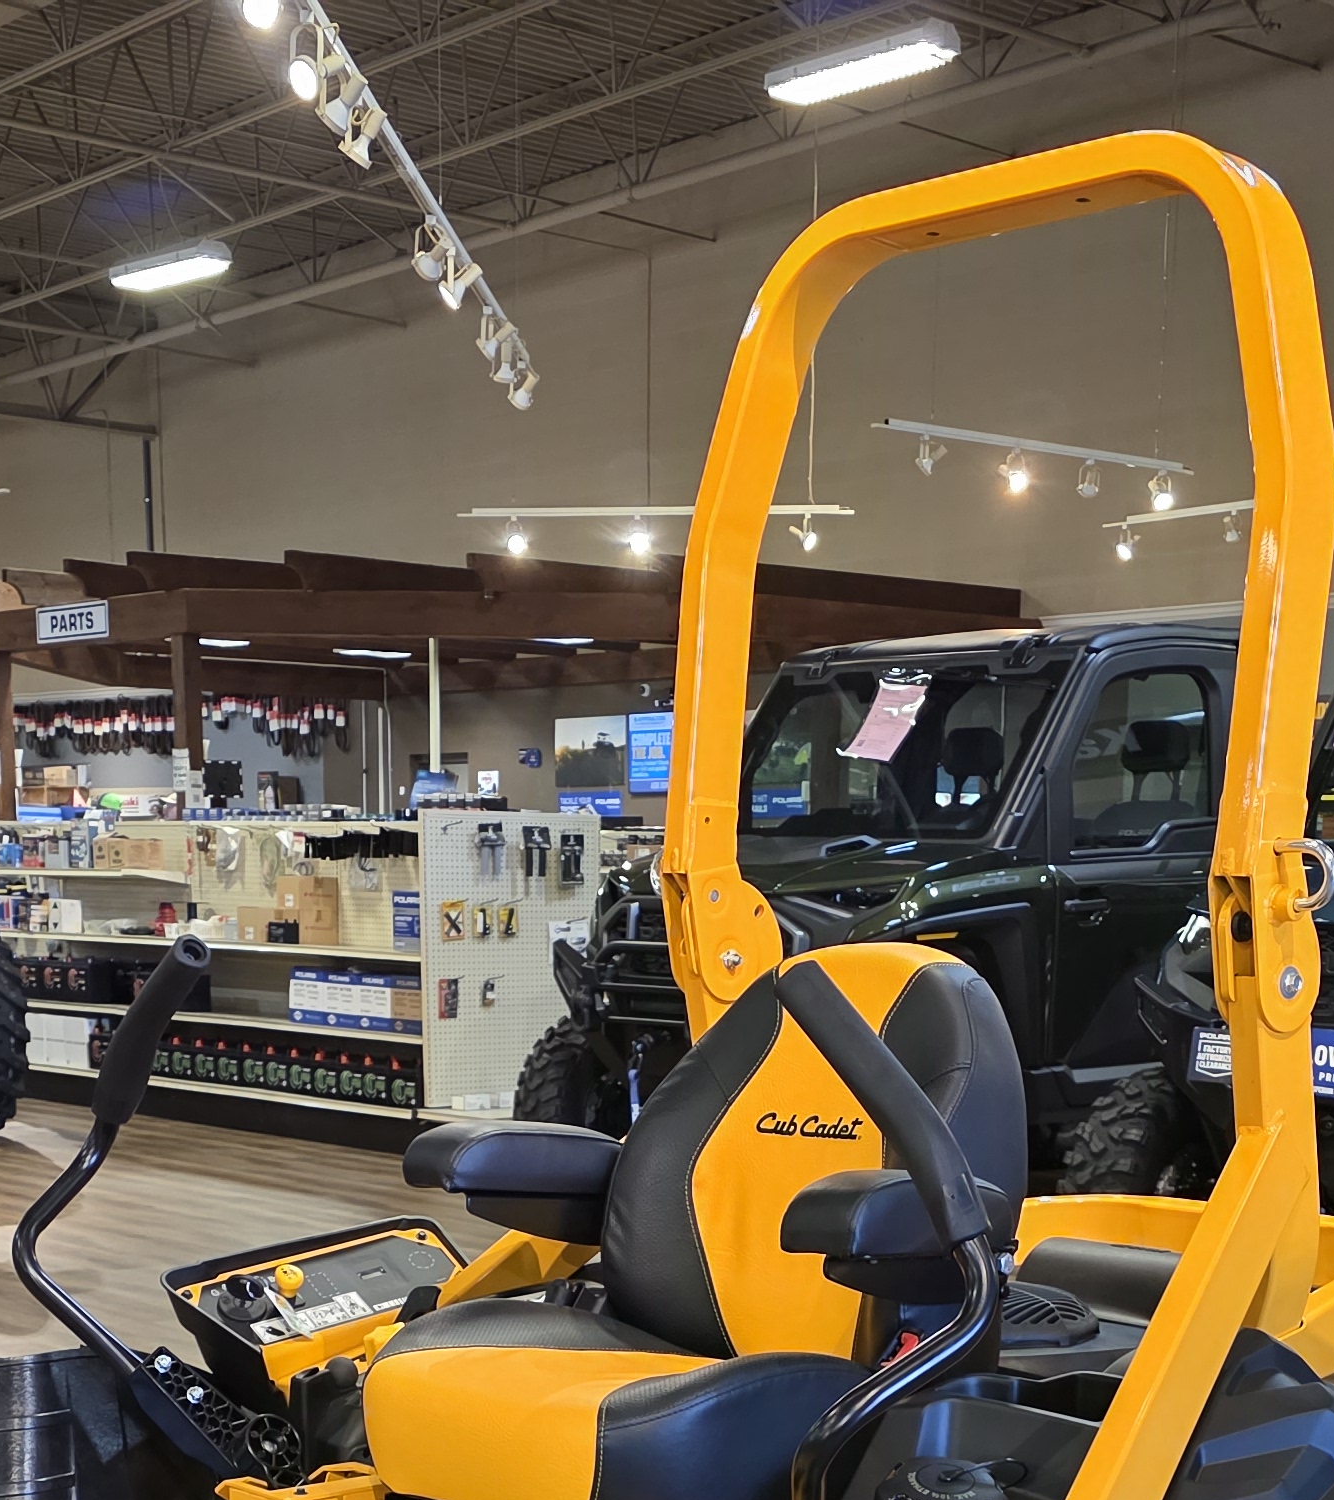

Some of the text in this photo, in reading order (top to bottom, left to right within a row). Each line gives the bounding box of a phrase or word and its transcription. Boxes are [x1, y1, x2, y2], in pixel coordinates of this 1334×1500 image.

[50, 611, 94, 633] PARTS
[756, 1112, 864, 1140] Cub Cadet
